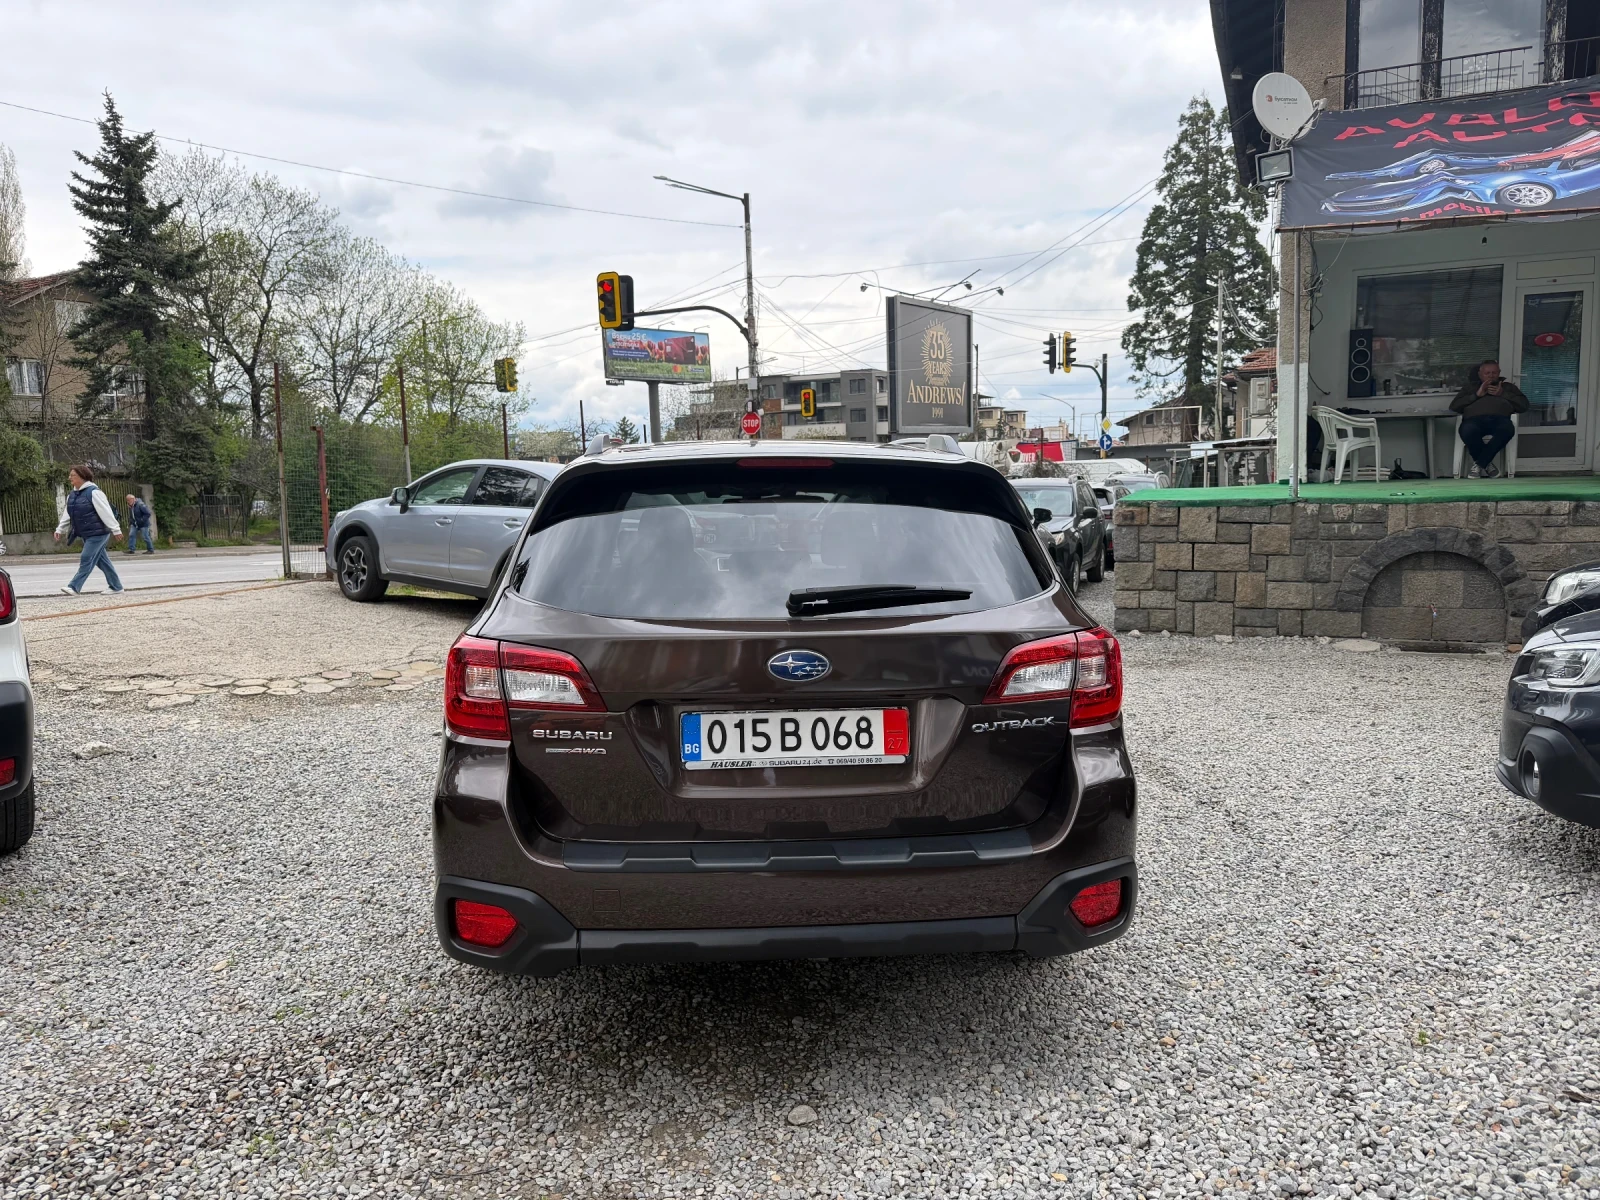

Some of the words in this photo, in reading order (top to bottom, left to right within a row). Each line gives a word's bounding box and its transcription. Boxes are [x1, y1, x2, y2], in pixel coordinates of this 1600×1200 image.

[631, 332, 641, 341] 25
[641, 333, 647, 341] €
[929, 330, 945, 359] 35
[929, 361, 947, 374] YEARS
[743, 419, 759, 428] STOP
[971, 716, 1055, 733] OUTBACK
[532, 729, 613, 740] SUBARU
[684, 743, 700, 754] BG
[887, 737, 904, 750] 27
